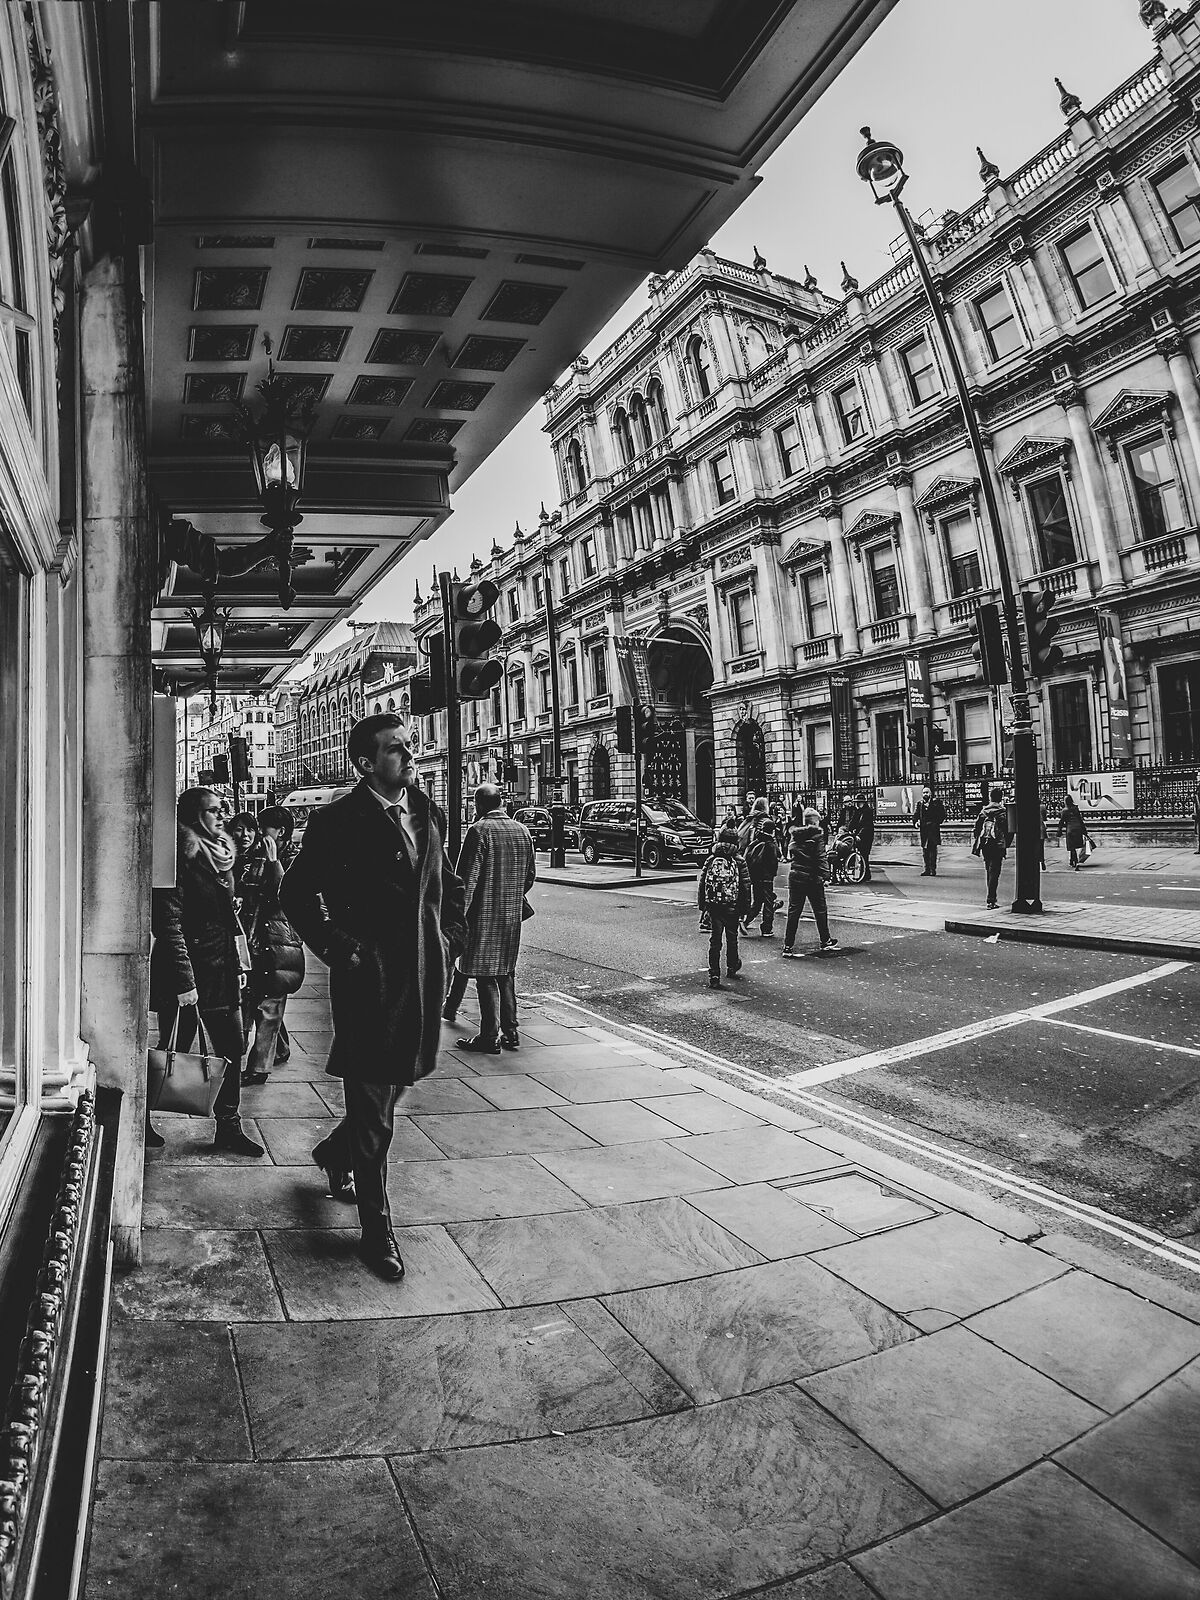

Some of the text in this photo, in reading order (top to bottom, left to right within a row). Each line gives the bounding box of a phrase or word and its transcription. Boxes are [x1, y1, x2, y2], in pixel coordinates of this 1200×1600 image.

[907, 660, 923, 681] RA
[490, 748, 498, 758] RA
[513, 743, 523, 755] RA
